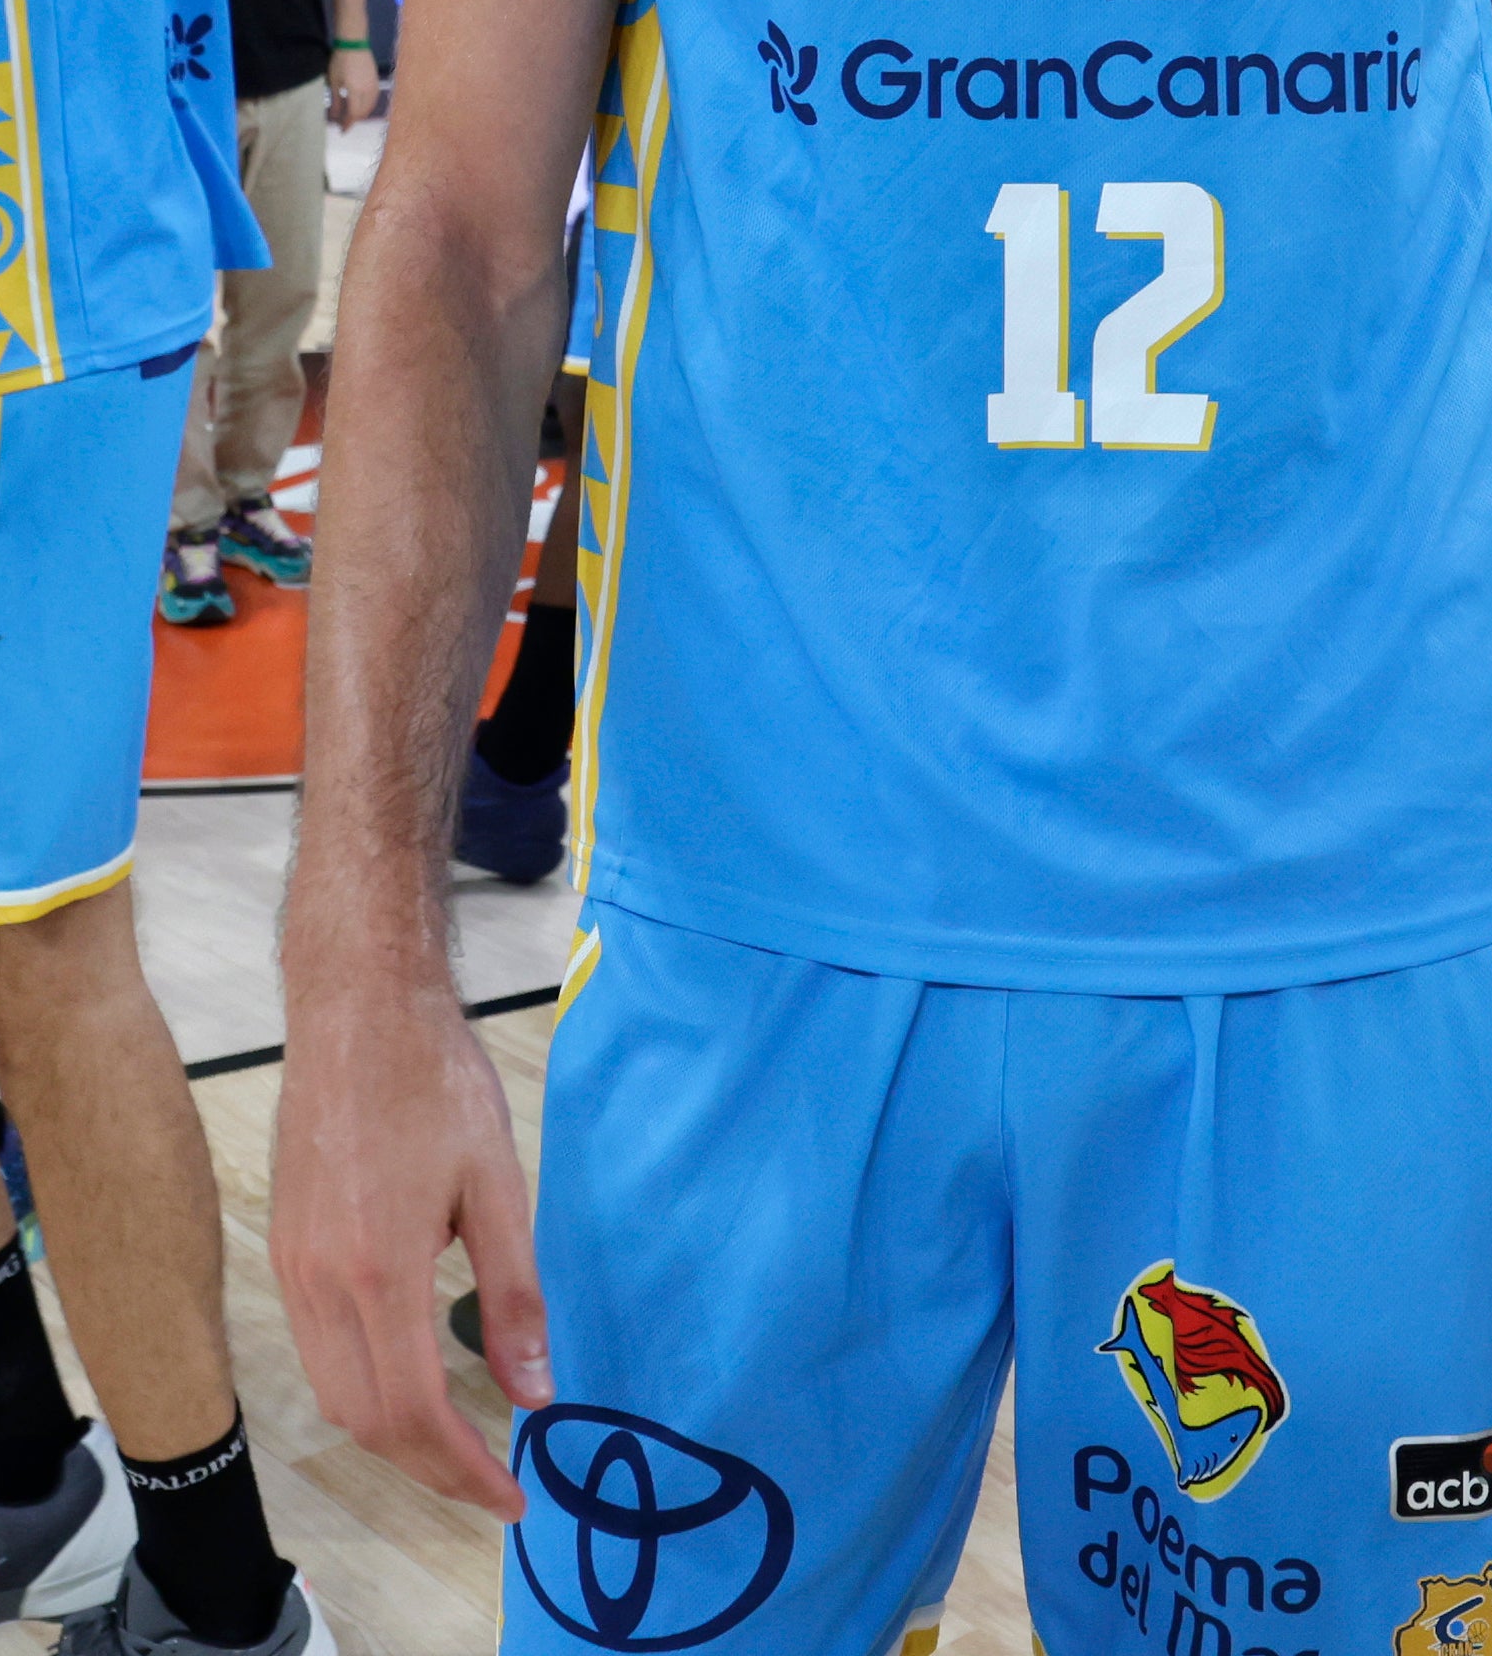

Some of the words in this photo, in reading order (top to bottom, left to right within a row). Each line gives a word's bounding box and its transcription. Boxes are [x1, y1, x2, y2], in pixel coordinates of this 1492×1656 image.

[985, 181, 1224, 451] 12
[1074, 1445, 1321, 1614] Poema
[1407, 1471, 1489, 1511] acb
[1078, 1531, 1150, 1636] del
